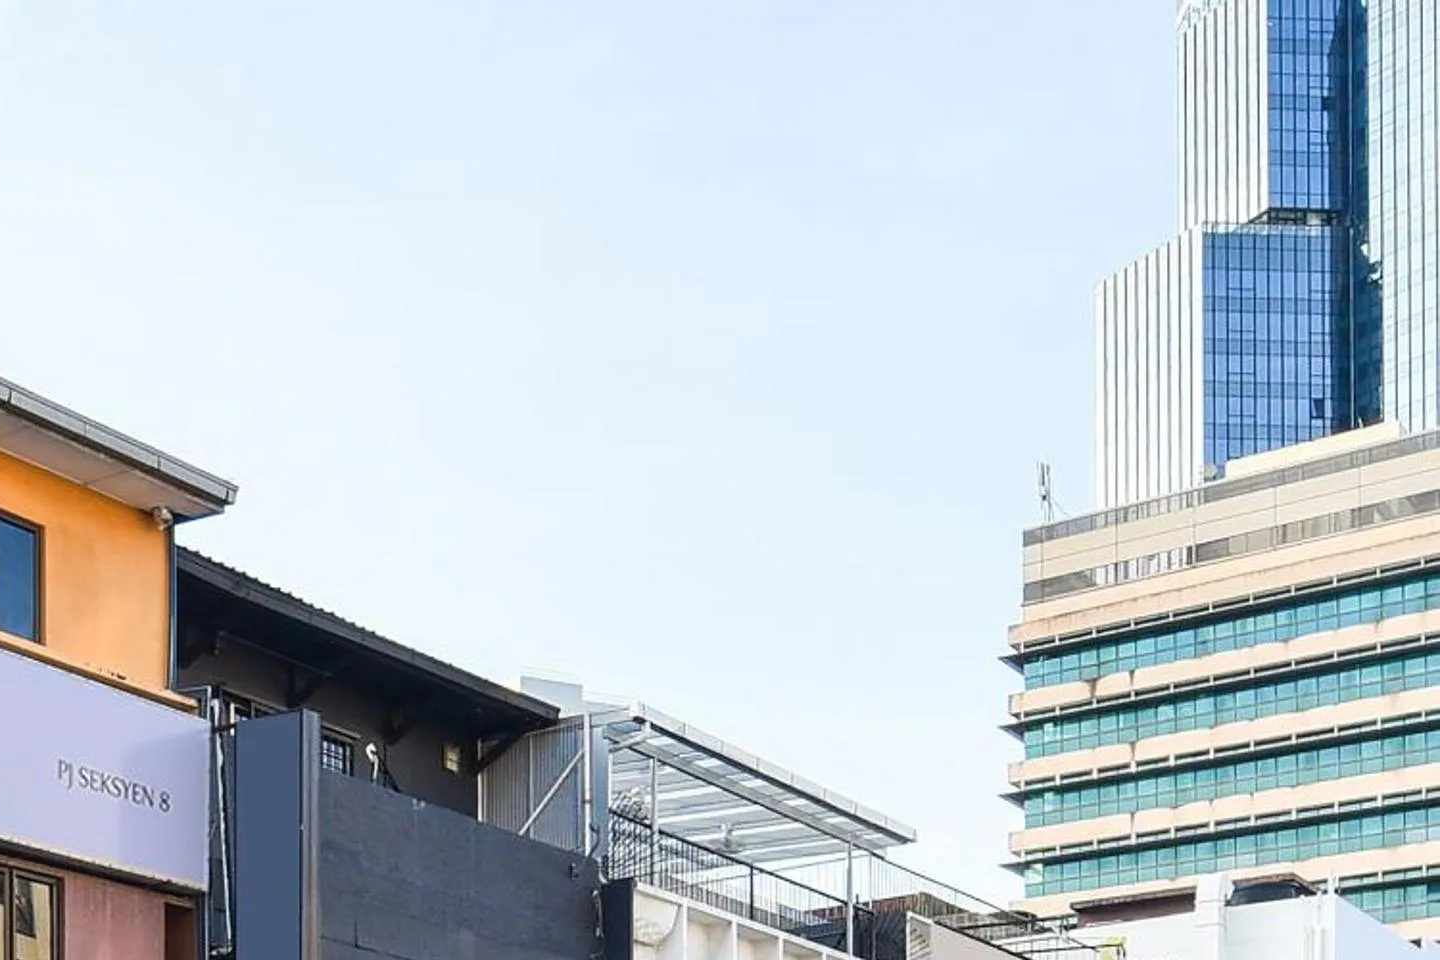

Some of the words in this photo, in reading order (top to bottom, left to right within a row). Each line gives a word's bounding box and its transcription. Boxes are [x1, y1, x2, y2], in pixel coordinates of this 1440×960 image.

[57, 758, 74, 790] PJ
[77, 766, 155, 808] SEKSYEN
[159, 790, 171, 813] 8
